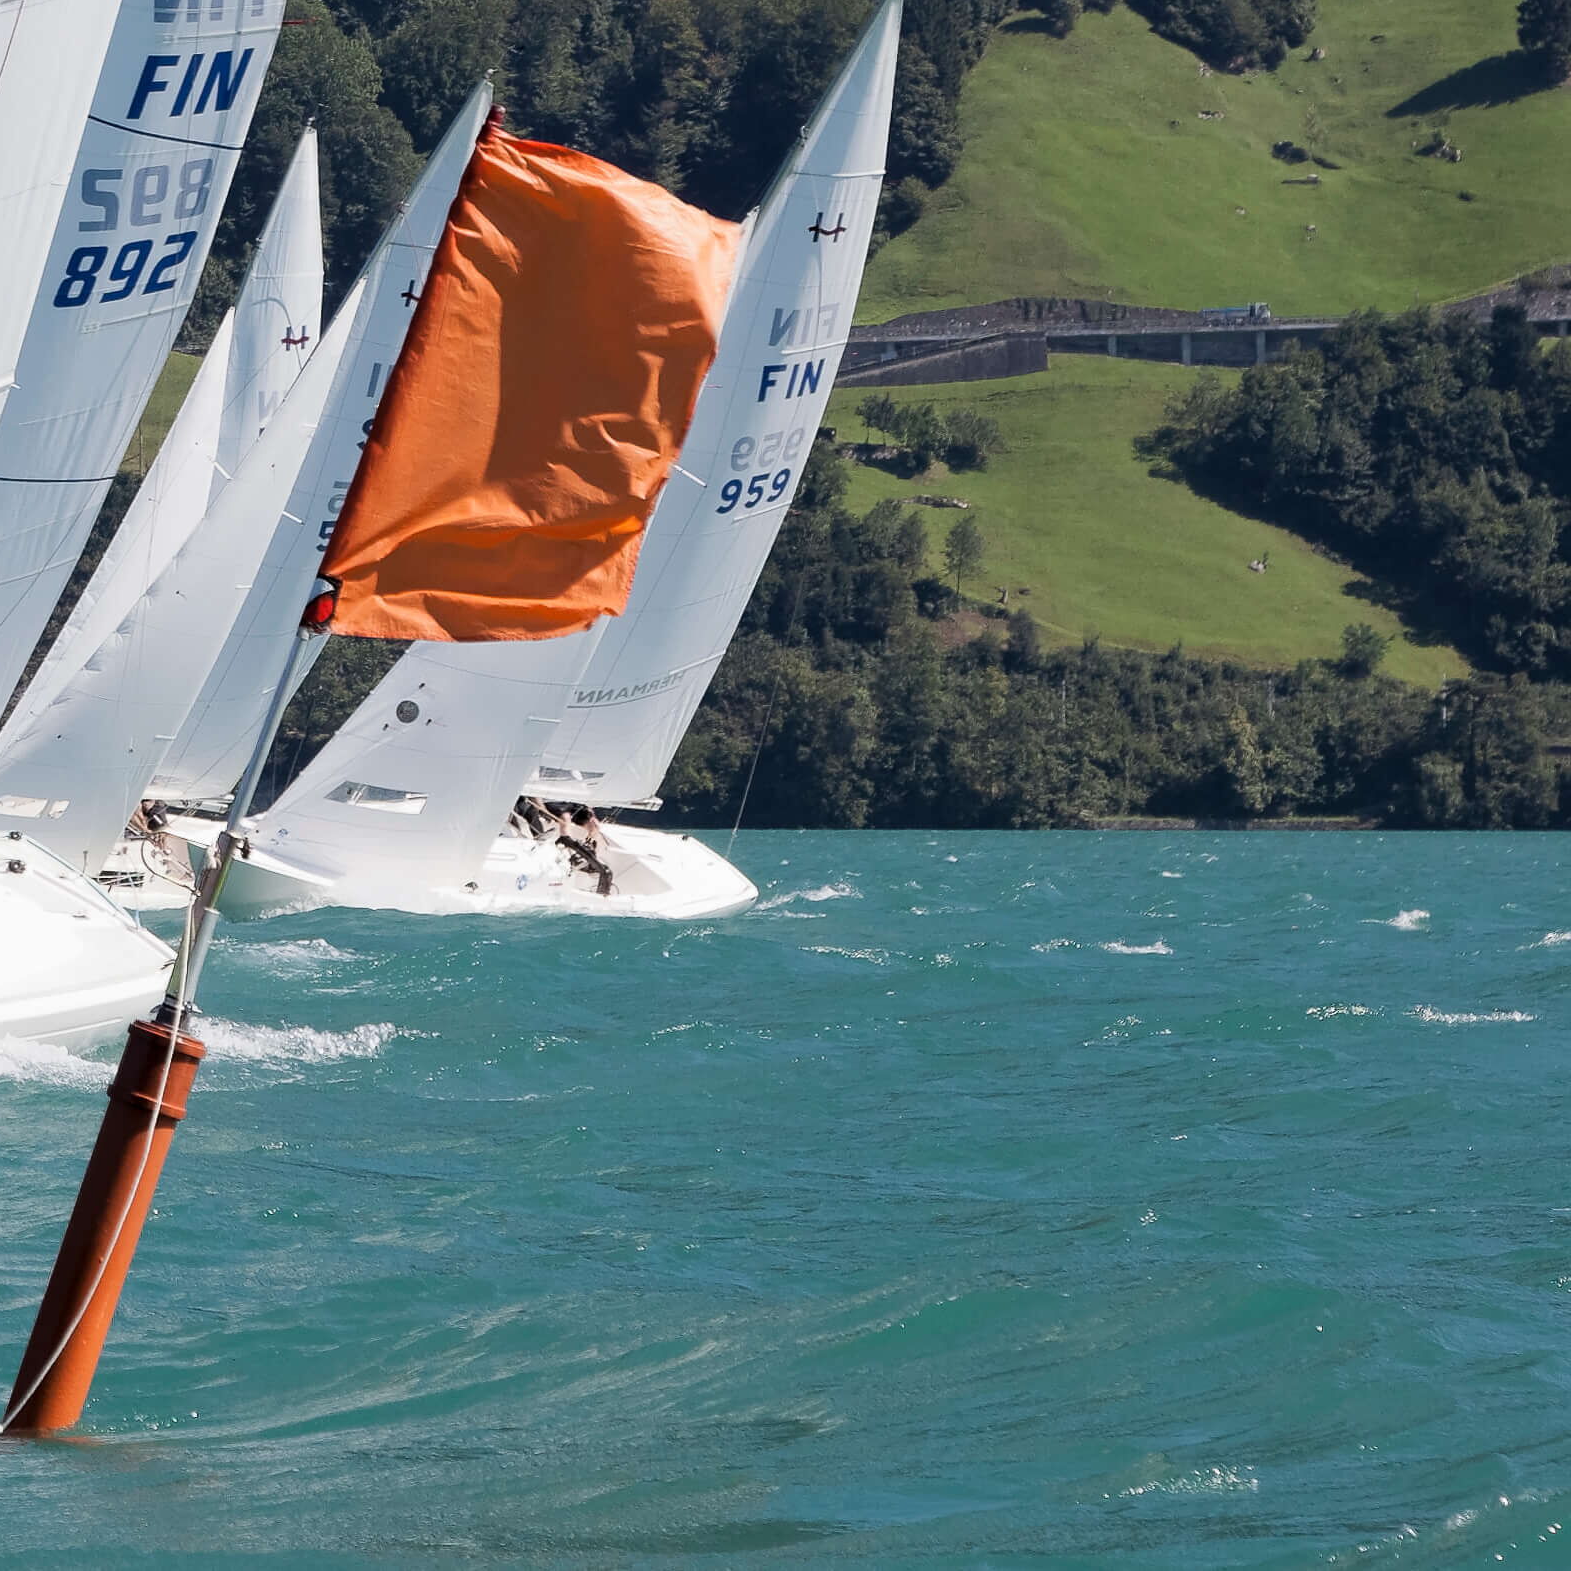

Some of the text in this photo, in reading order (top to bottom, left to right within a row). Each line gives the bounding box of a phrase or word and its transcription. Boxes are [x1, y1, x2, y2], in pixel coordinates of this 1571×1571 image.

[126, 48, 255, 120] FIN
[53, 231, 198, 308] 892
[758, 359, 825, 402] FIN
[716, 467, 791, 515] 959
